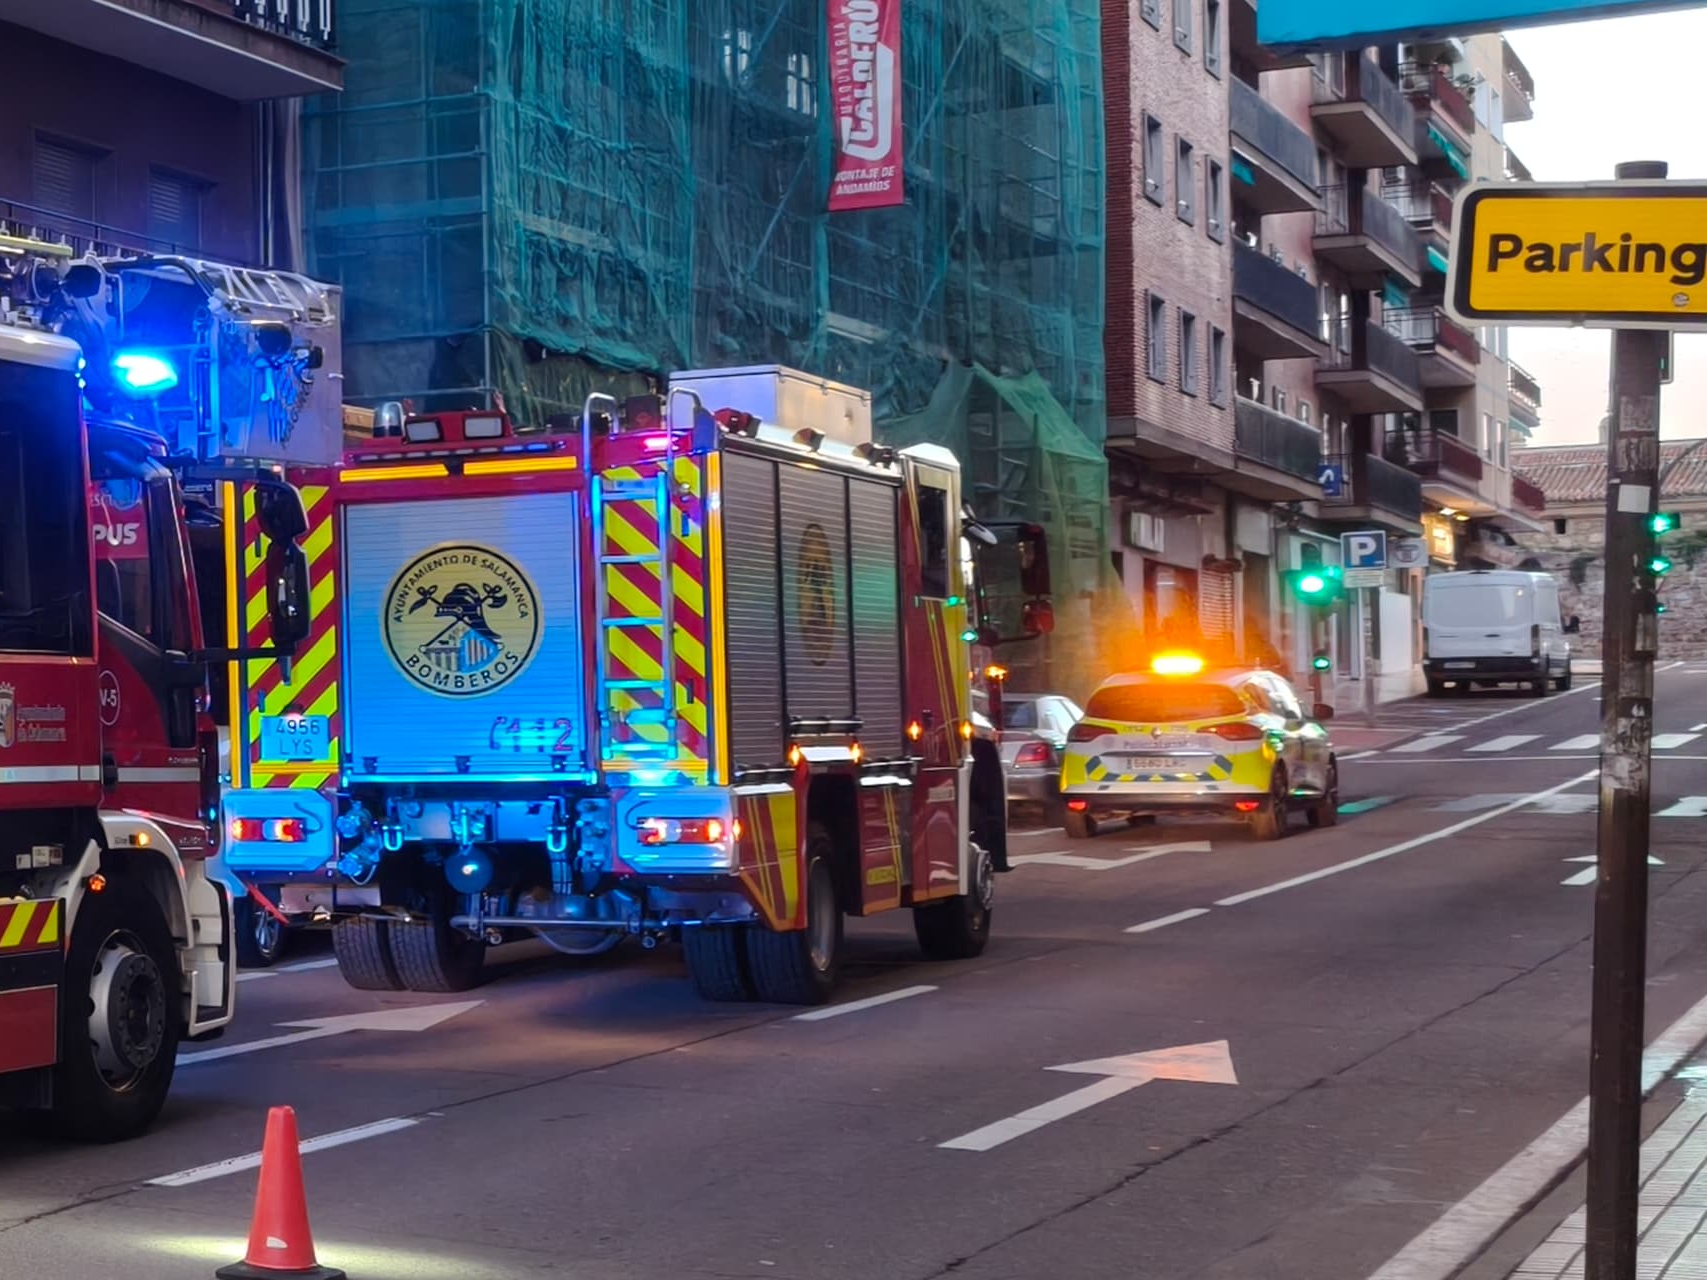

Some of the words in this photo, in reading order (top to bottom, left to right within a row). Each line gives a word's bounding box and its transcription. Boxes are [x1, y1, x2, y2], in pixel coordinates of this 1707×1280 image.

[881, 165, 896, 178] DE
[1487, 231, 1707, 287] Parking
[1350, 536, 1378, 567] P
[392, 553, 459, 624] AYUNTAMIENTO
[461, 553, 479, 567] DE
[480, 557, 530, 620] SALAMANCA
[404, 649, 520, 690] BOMBEROS
[98, 688, 119, 708] V-5
[275, 718, 321, 735] 4956
[279, 737, 313, 756] LYS
